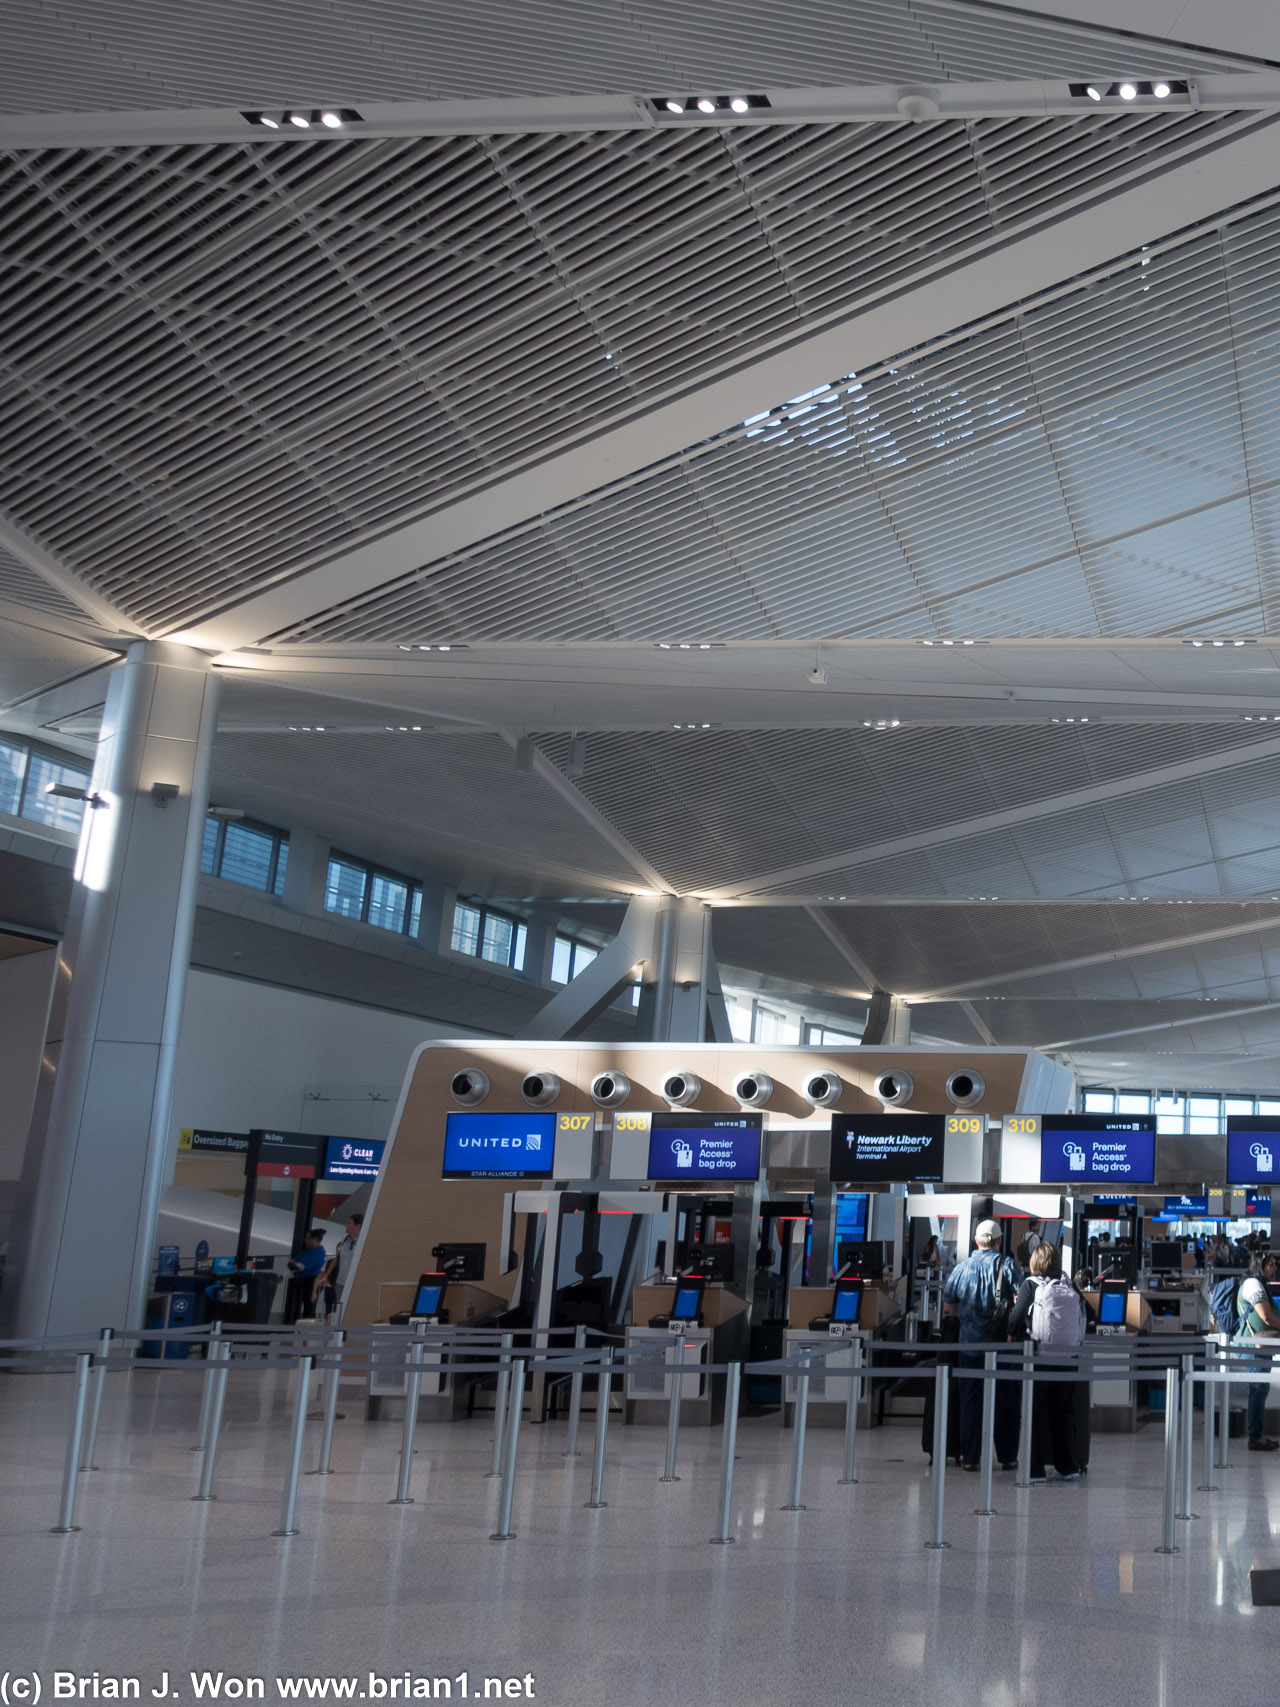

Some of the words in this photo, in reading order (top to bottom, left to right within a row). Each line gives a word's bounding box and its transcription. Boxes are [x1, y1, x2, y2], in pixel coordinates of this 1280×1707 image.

[559, 1116, 591, 1130] 307
[616, 1116, 648, 1131] 308
[948, 1118, 980, 1133] 309
[1008, 1119, 1036, 1133] 310
[193, 1134, 226, 1147] Oversized
[227, 1137, 249, 1150] Bagga
[459, 1137, 522, 1148] UNITED
[700, 1139, 734, 1149] Premier
[857, 1135, 896, 1145] Newark
[896, 1135, 933, 1147] Liberty
[856, 1145, 899, 1153] International
[900, 1145, 922, 1154] Airport
[1092, 1142, 1127, 1151] Premier
[353, 1148, 374, 1157] CLEAR
[698, 1159, 716, 1169] bag
[716, 1159, 737, 1169] drop
[1092, 1162, 1109, 1172] bag
[1110, 1162, 1131, 1172] drop
[1233, 1189, 1245, 1197] 210
